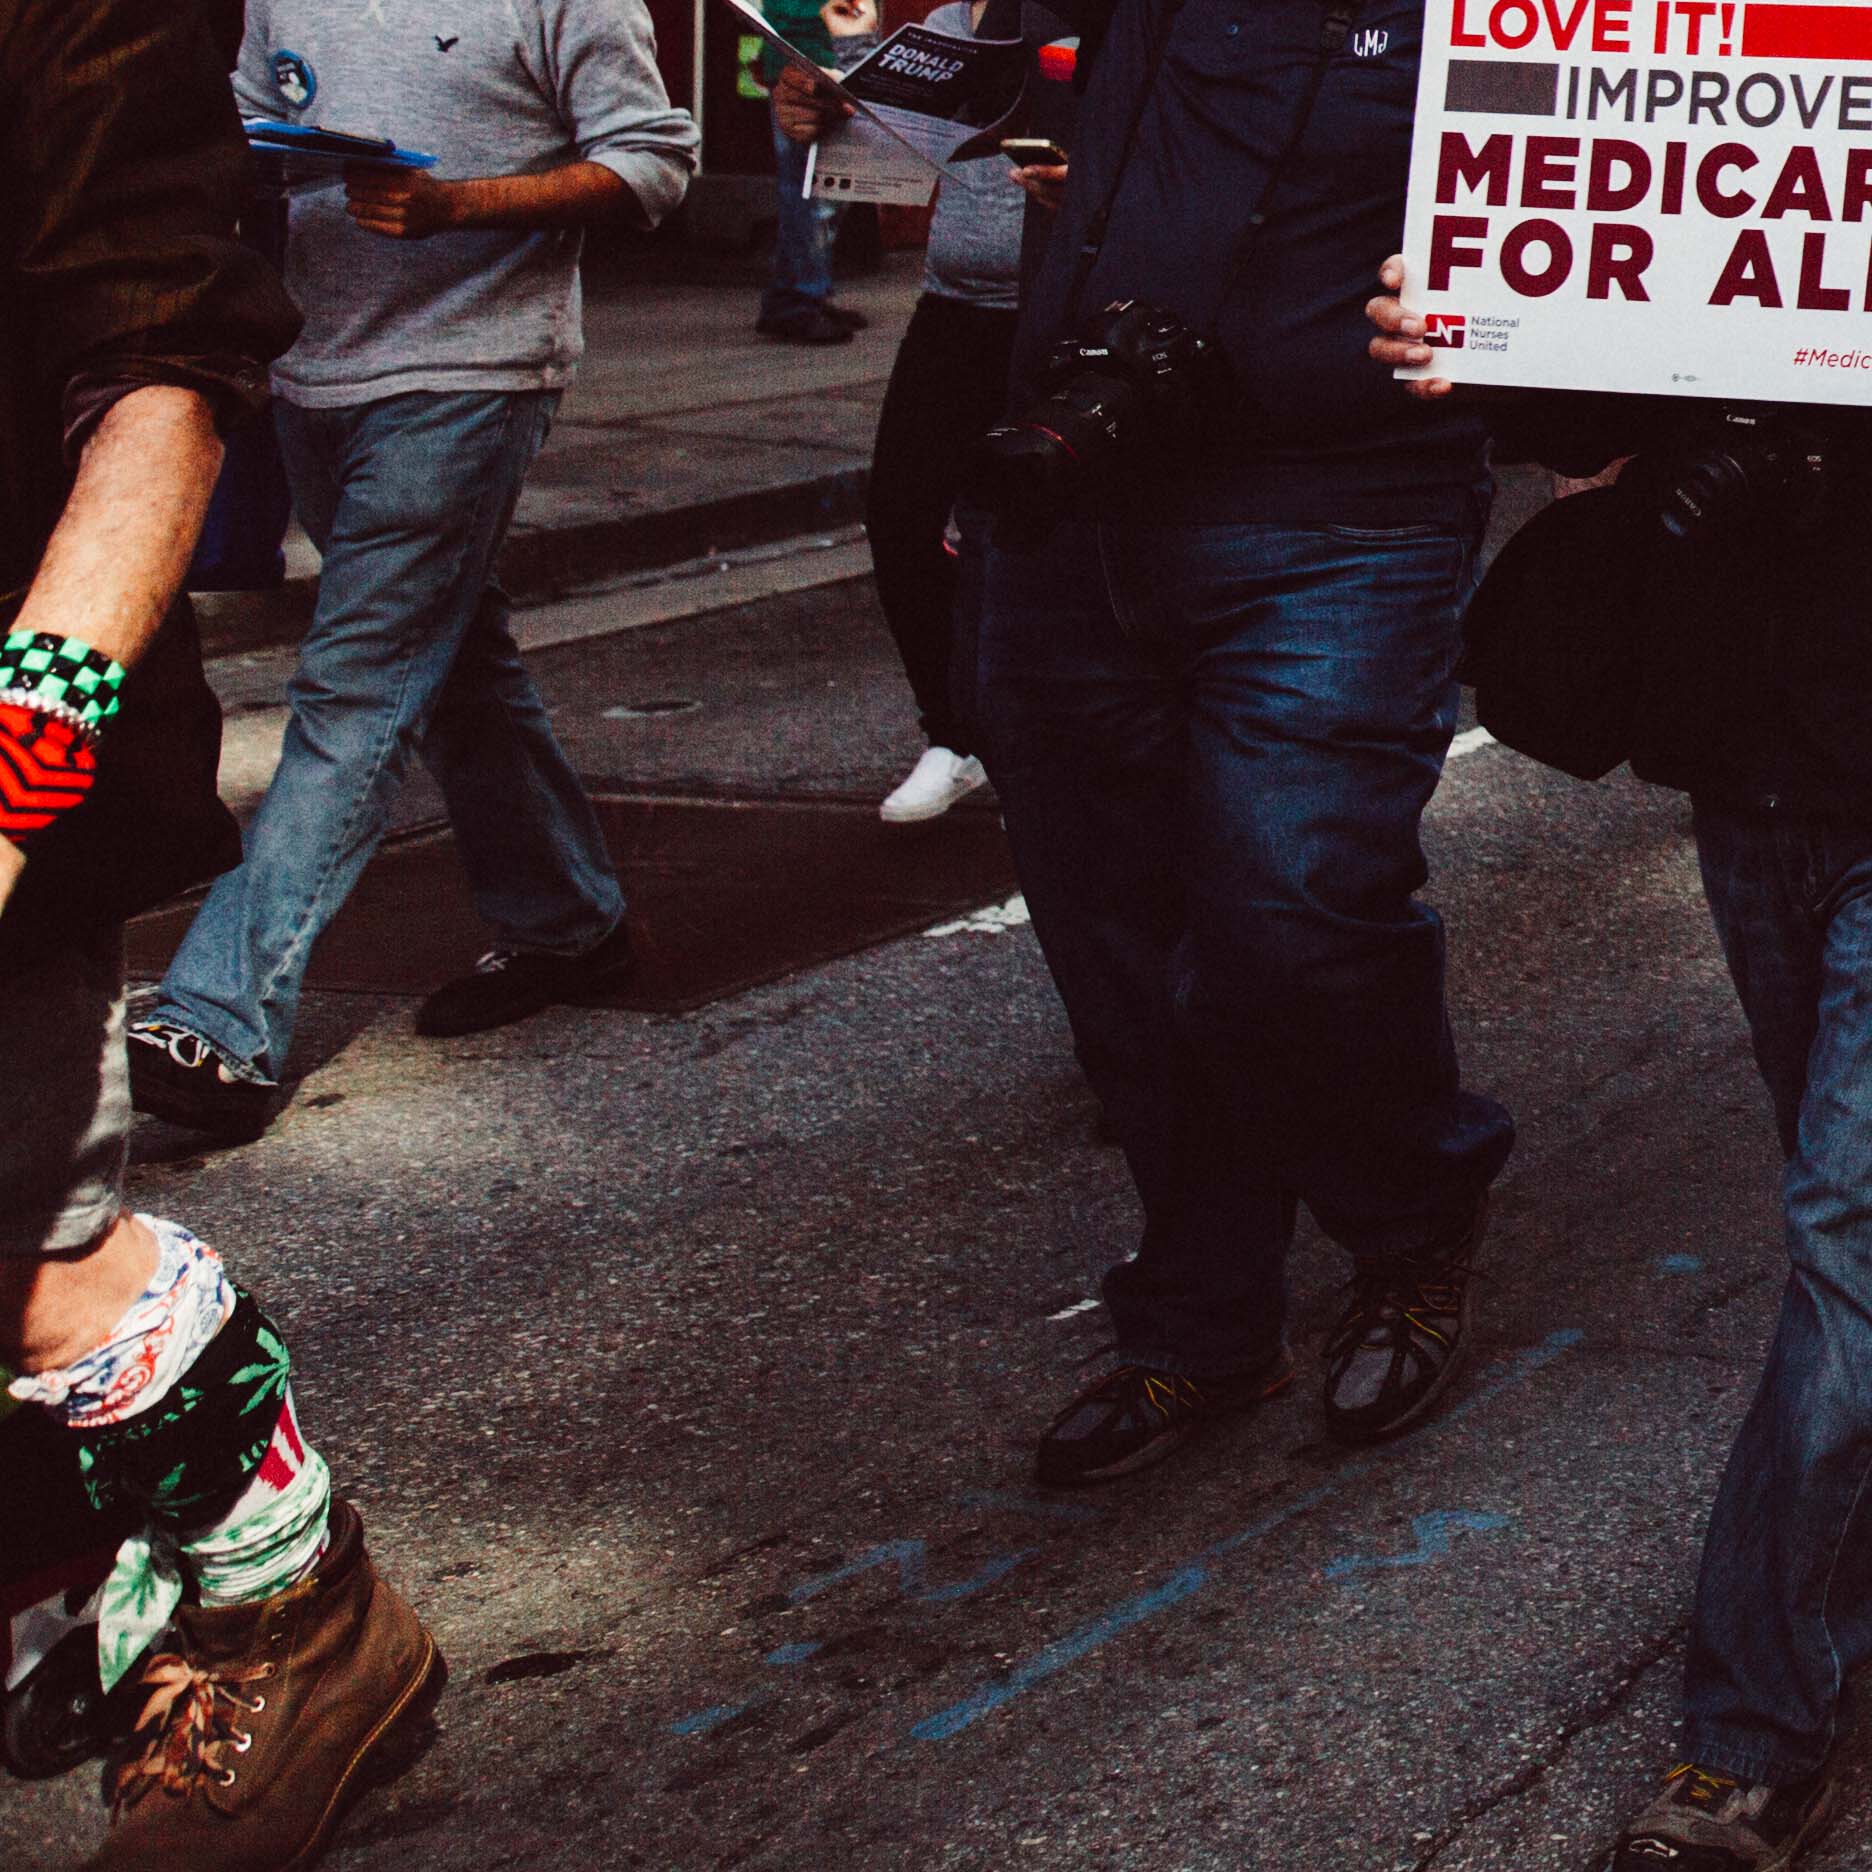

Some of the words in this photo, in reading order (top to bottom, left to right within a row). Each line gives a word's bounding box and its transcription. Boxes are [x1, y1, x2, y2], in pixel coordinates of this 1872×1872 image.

[1654, 0, 1736, 56] IT!
[878, 54, 954, 82] TRUMP
[888, 44, 964, 72] DONALD
[1427, 214, 1654, 302] FOR
[1471, 316, 1520, 328] National
[1470, 328, 1510, 340] Nurses
[1079, 348, 1108, 356] Canon
[1470, 340, 1508, 352] United
